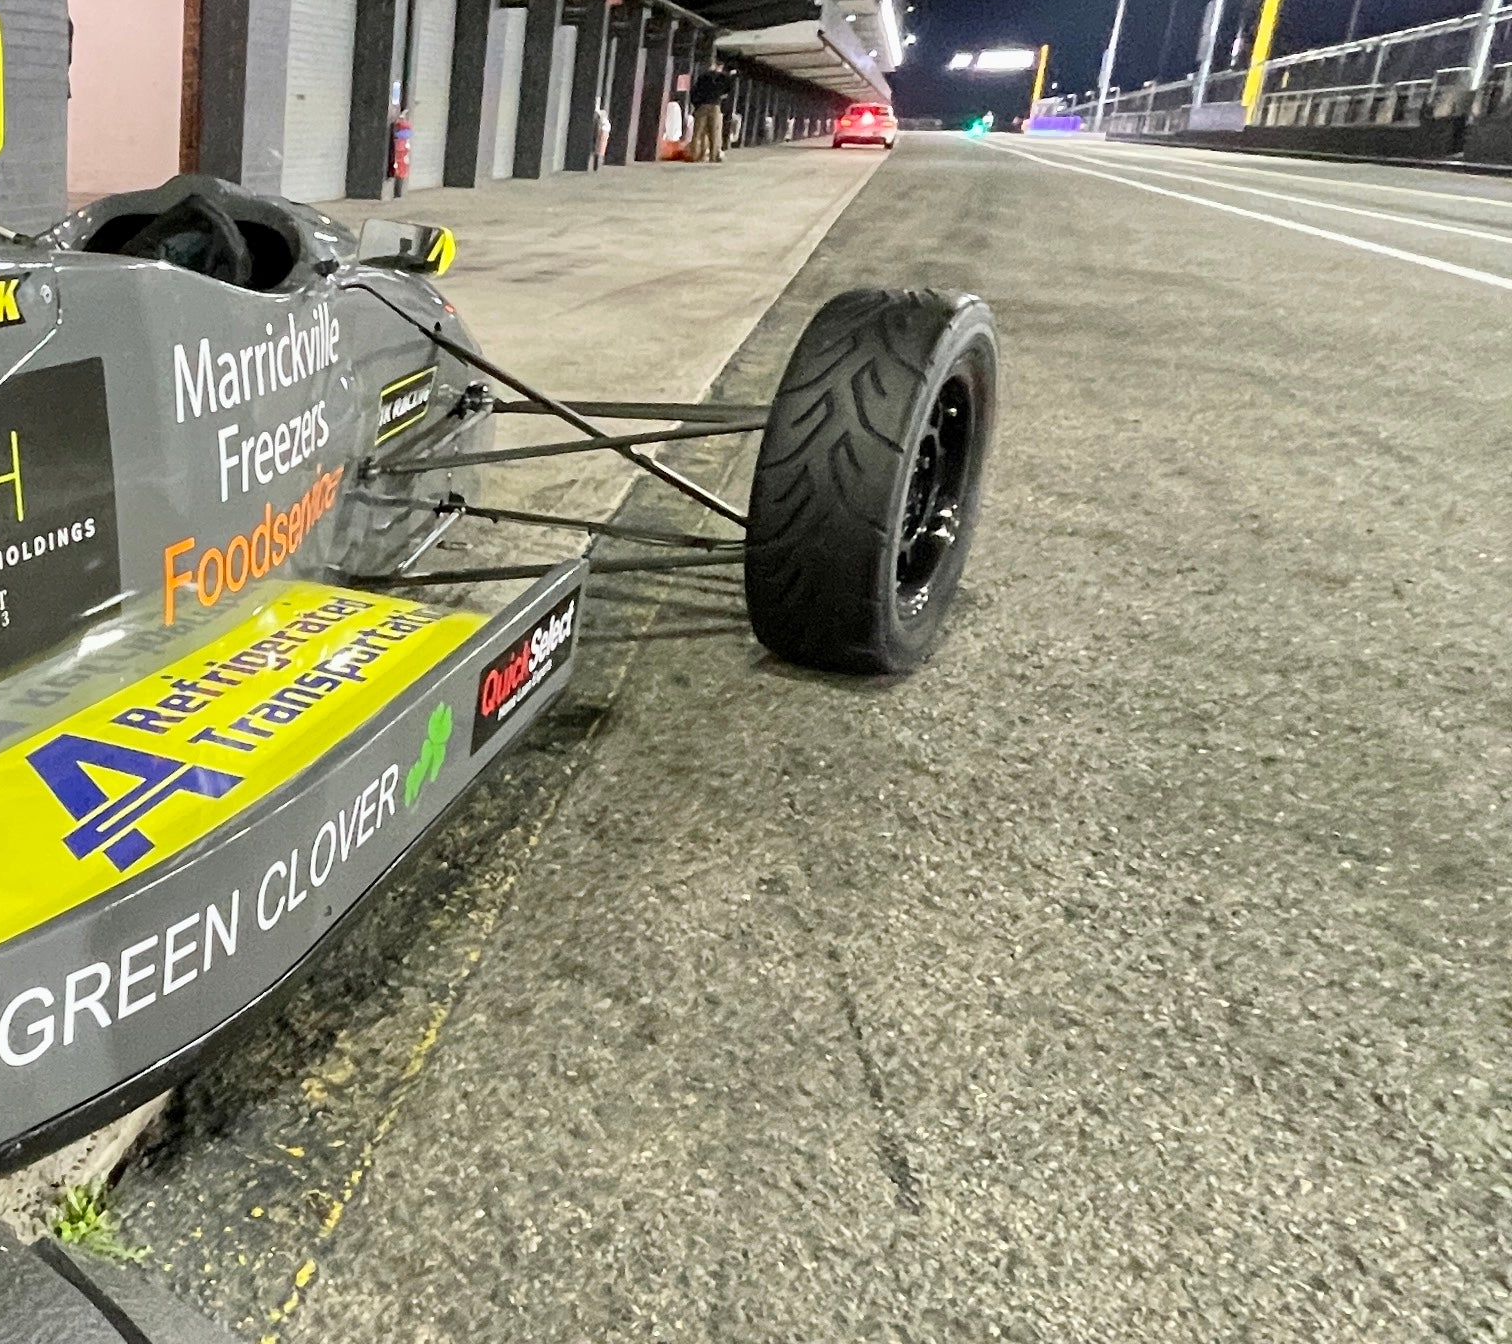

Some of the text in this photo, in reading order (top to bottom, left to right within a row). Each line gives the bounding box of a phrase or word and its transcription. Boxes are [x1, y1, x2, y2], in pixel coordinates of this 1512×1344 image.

[174, 302, 340, 424] Marrickville
[218, 400, 330, 503] Freezers
[164, 463, 345, 627] Foodservice
[110, 596, 376, 735] Refrigerated
[256, 763, 399, 931] CLOVER
